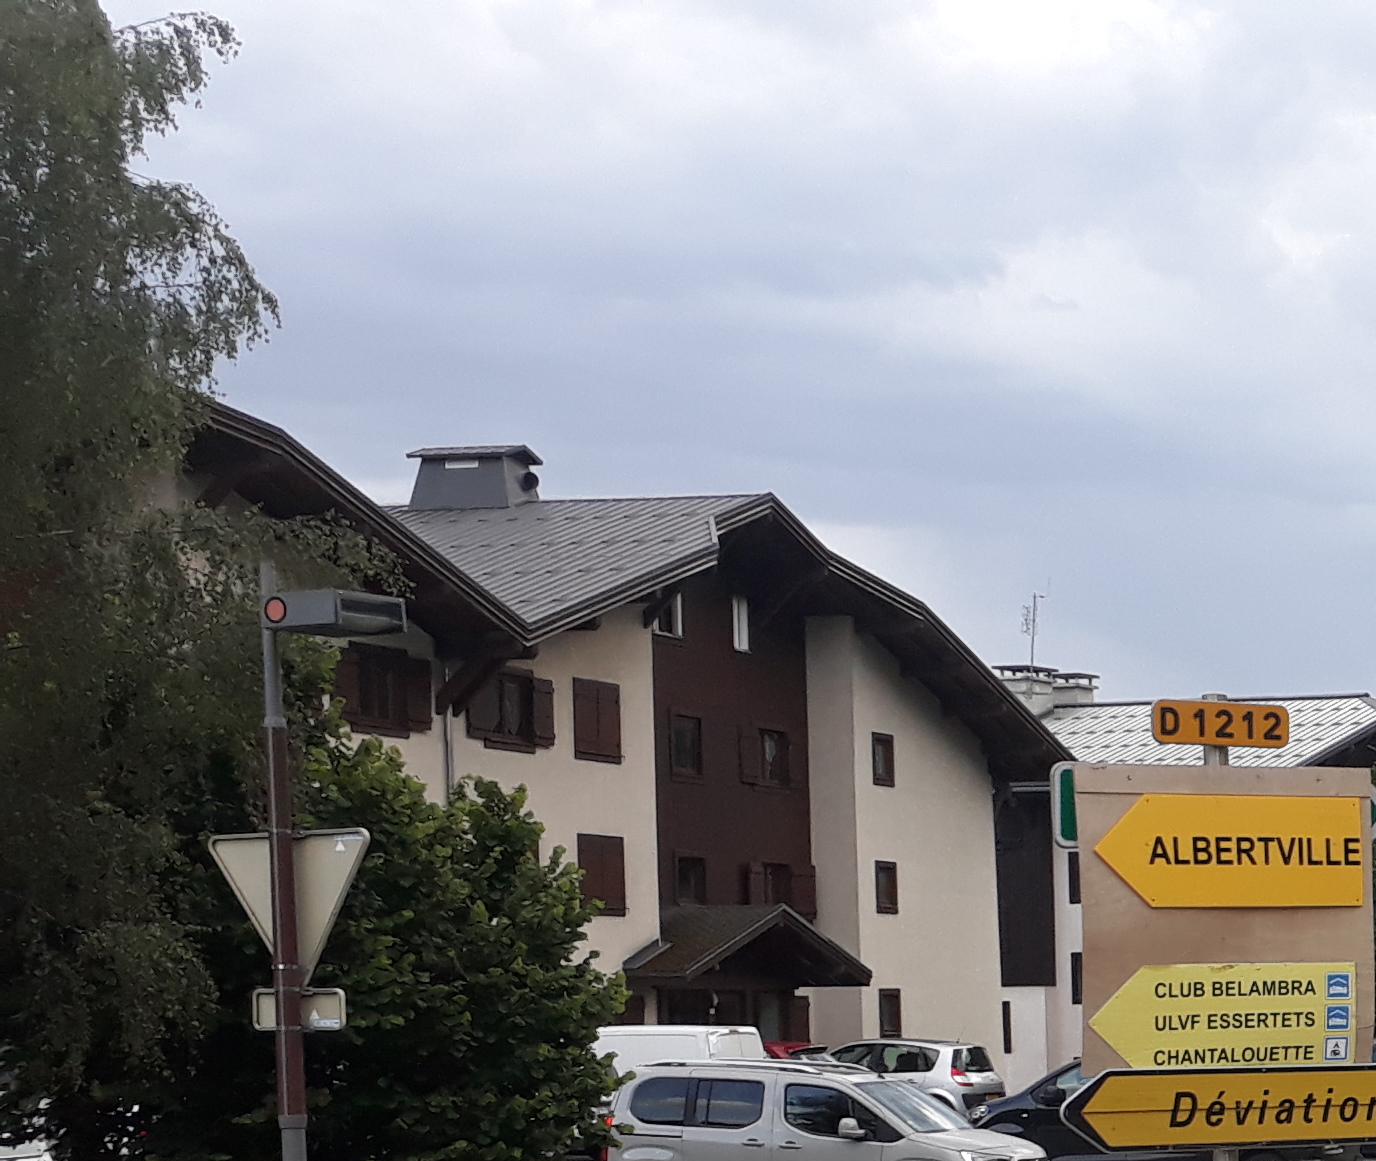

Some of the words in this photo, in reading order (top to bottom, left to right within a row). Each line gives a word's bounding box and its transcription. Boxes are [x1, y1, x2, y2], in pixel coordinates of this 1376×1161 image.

[1160, 706, 1180, 736] D
[1193, 708, 1283, 740] 1212
[1149, 836, 1362, 866] ALBERTVILLE
[1154, 982, 1206, 999] CLUB
[1211, 980, 1317, 997] BELAMBRA
[1154, 1014, 1201, 1031] ULVF
[1207, 1011, 1316, 1030] ESSERTETS
[1153, 1045, 1315, 1066] CHANTALOUETTE
